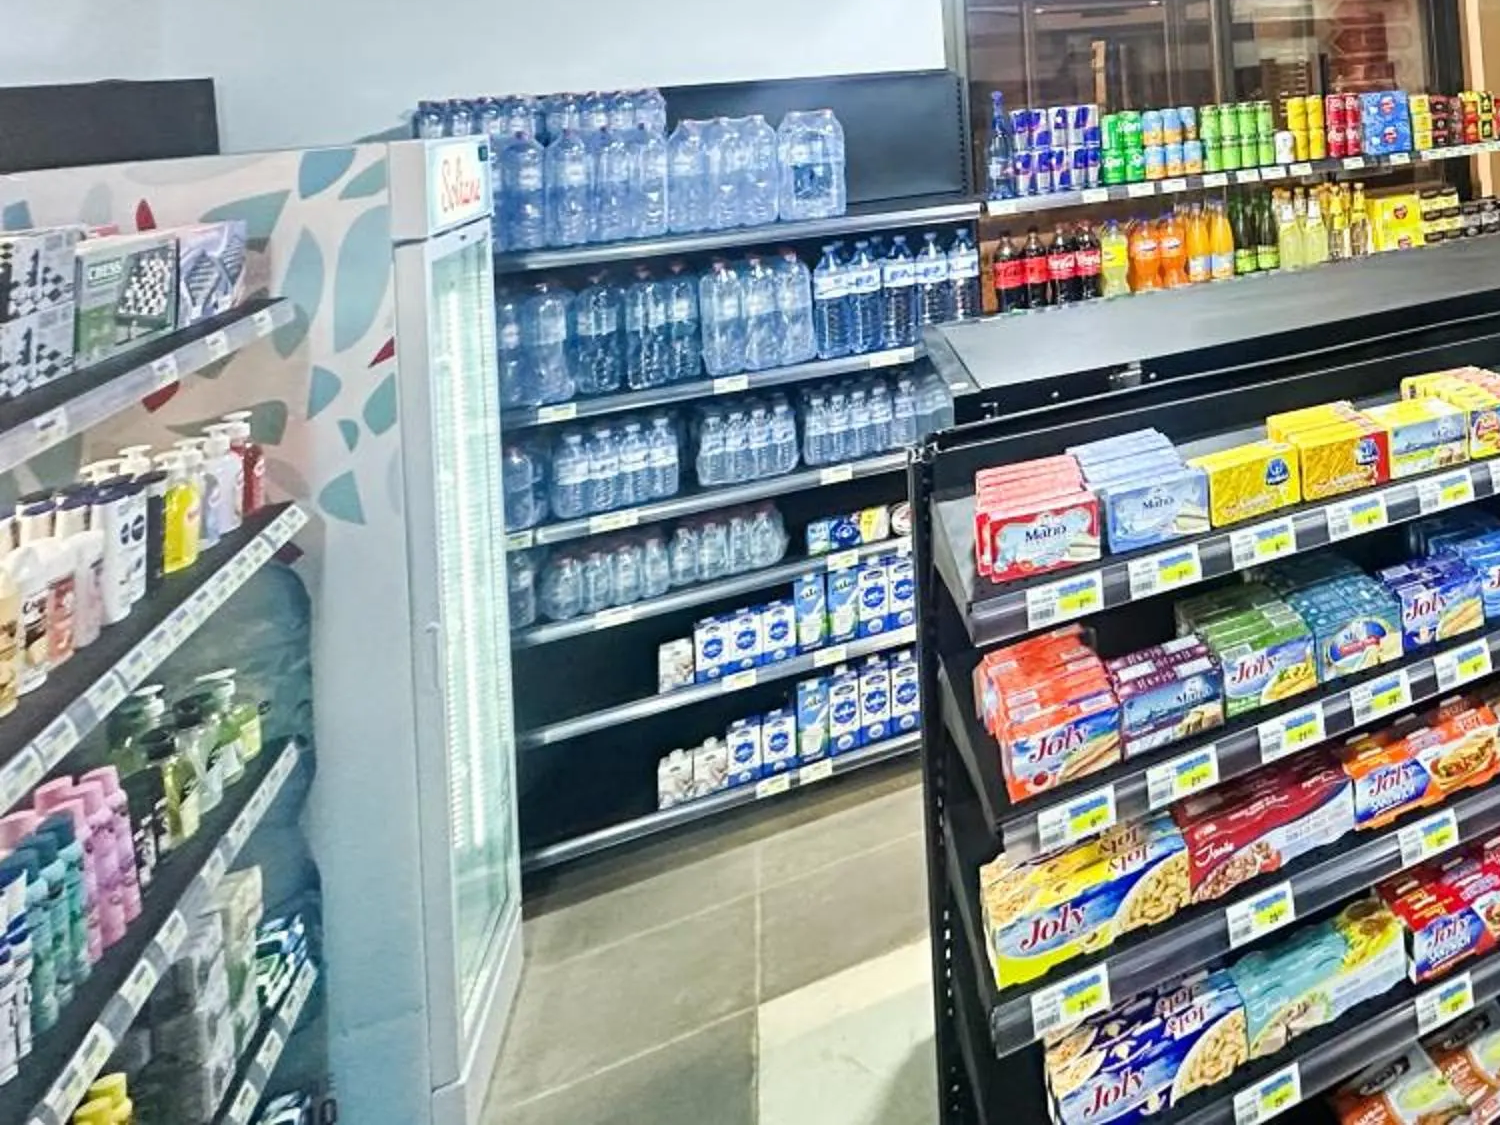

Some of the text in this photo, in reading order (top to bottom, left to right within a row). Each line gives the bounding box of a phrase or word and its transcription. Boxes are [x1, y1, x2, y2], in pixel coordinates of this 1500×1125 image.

[1404, 591, 1450, 622] Joly
[1230, 655, 1280, 684] Joly
[1028, 724, 1090, 764] Joly
[1368, 763, 1419, 797] Joly
[1019, 900, 1087, 951] Joly
[1083, 1066, 1146, 1117] Joly
